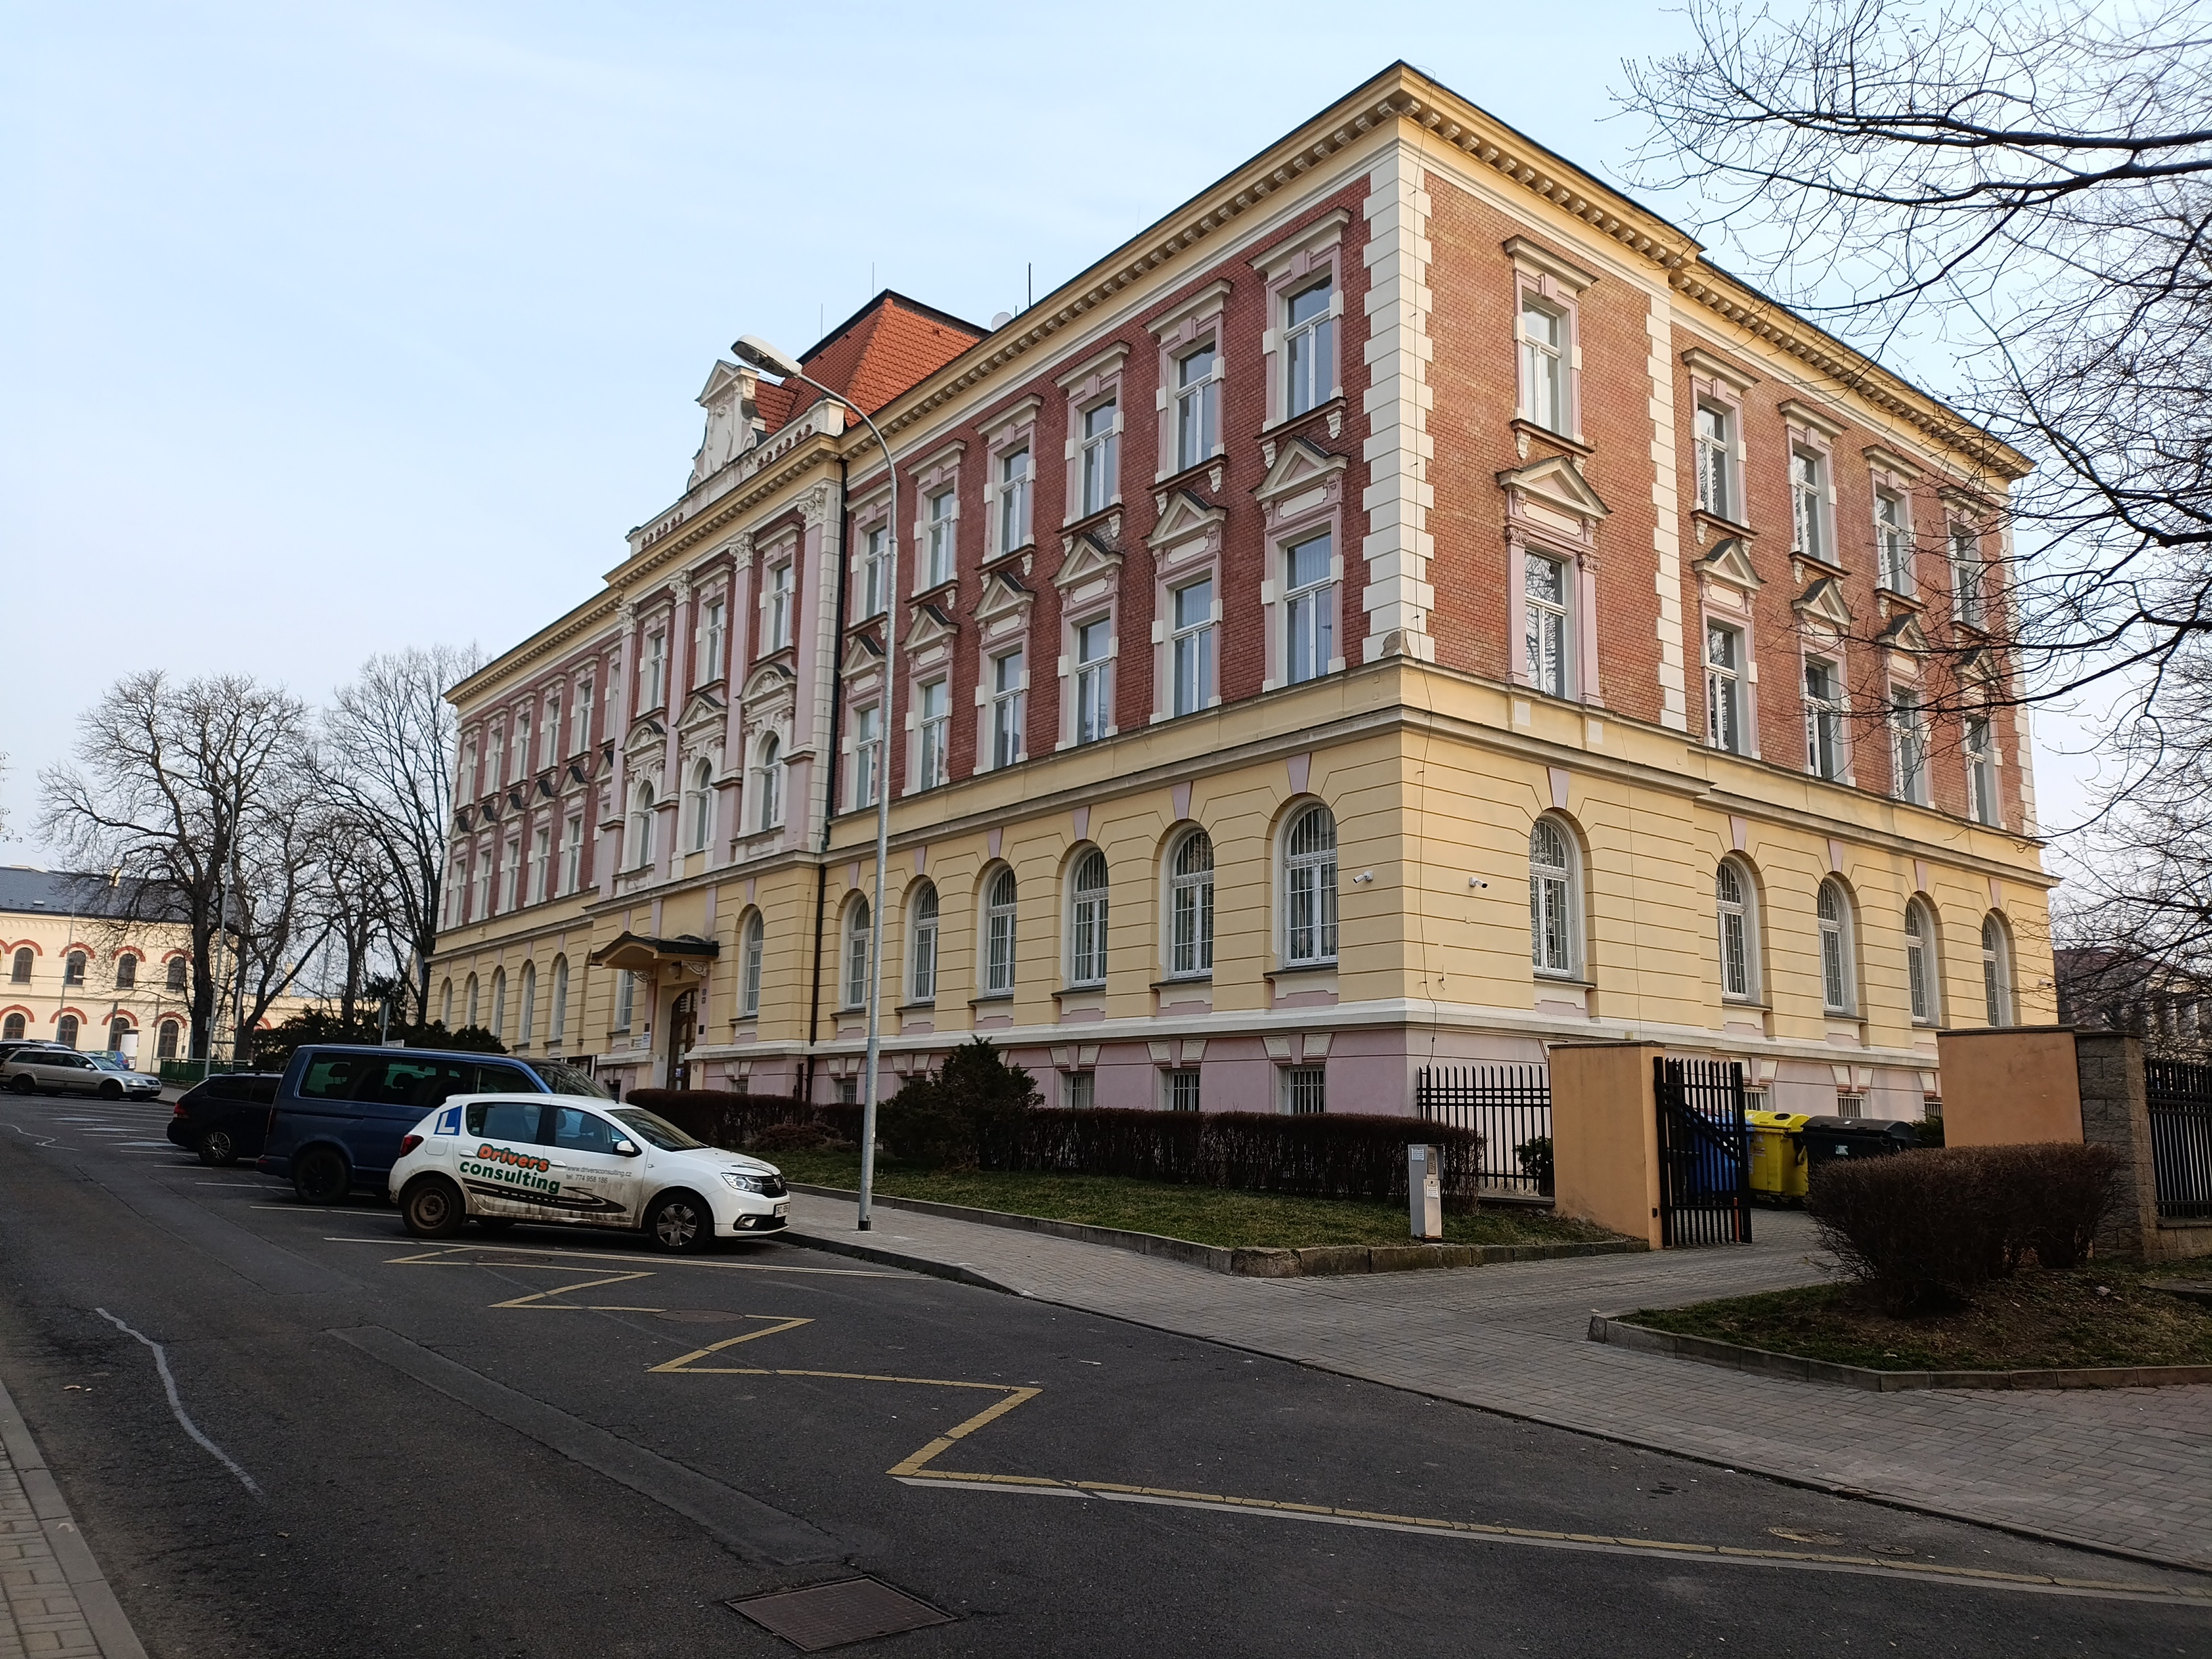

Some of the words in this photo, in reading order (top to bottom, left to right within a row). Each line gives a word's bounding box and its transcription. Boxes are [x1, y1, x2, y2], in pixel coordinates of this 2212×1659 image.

[437, 1111, 455, 1134] L
[476, 1143, 550, 1172] Drivers
[459, 1161, 560, 1194] consulting
[567, 1166, 632, 1177] www.driversconsulting.cz
